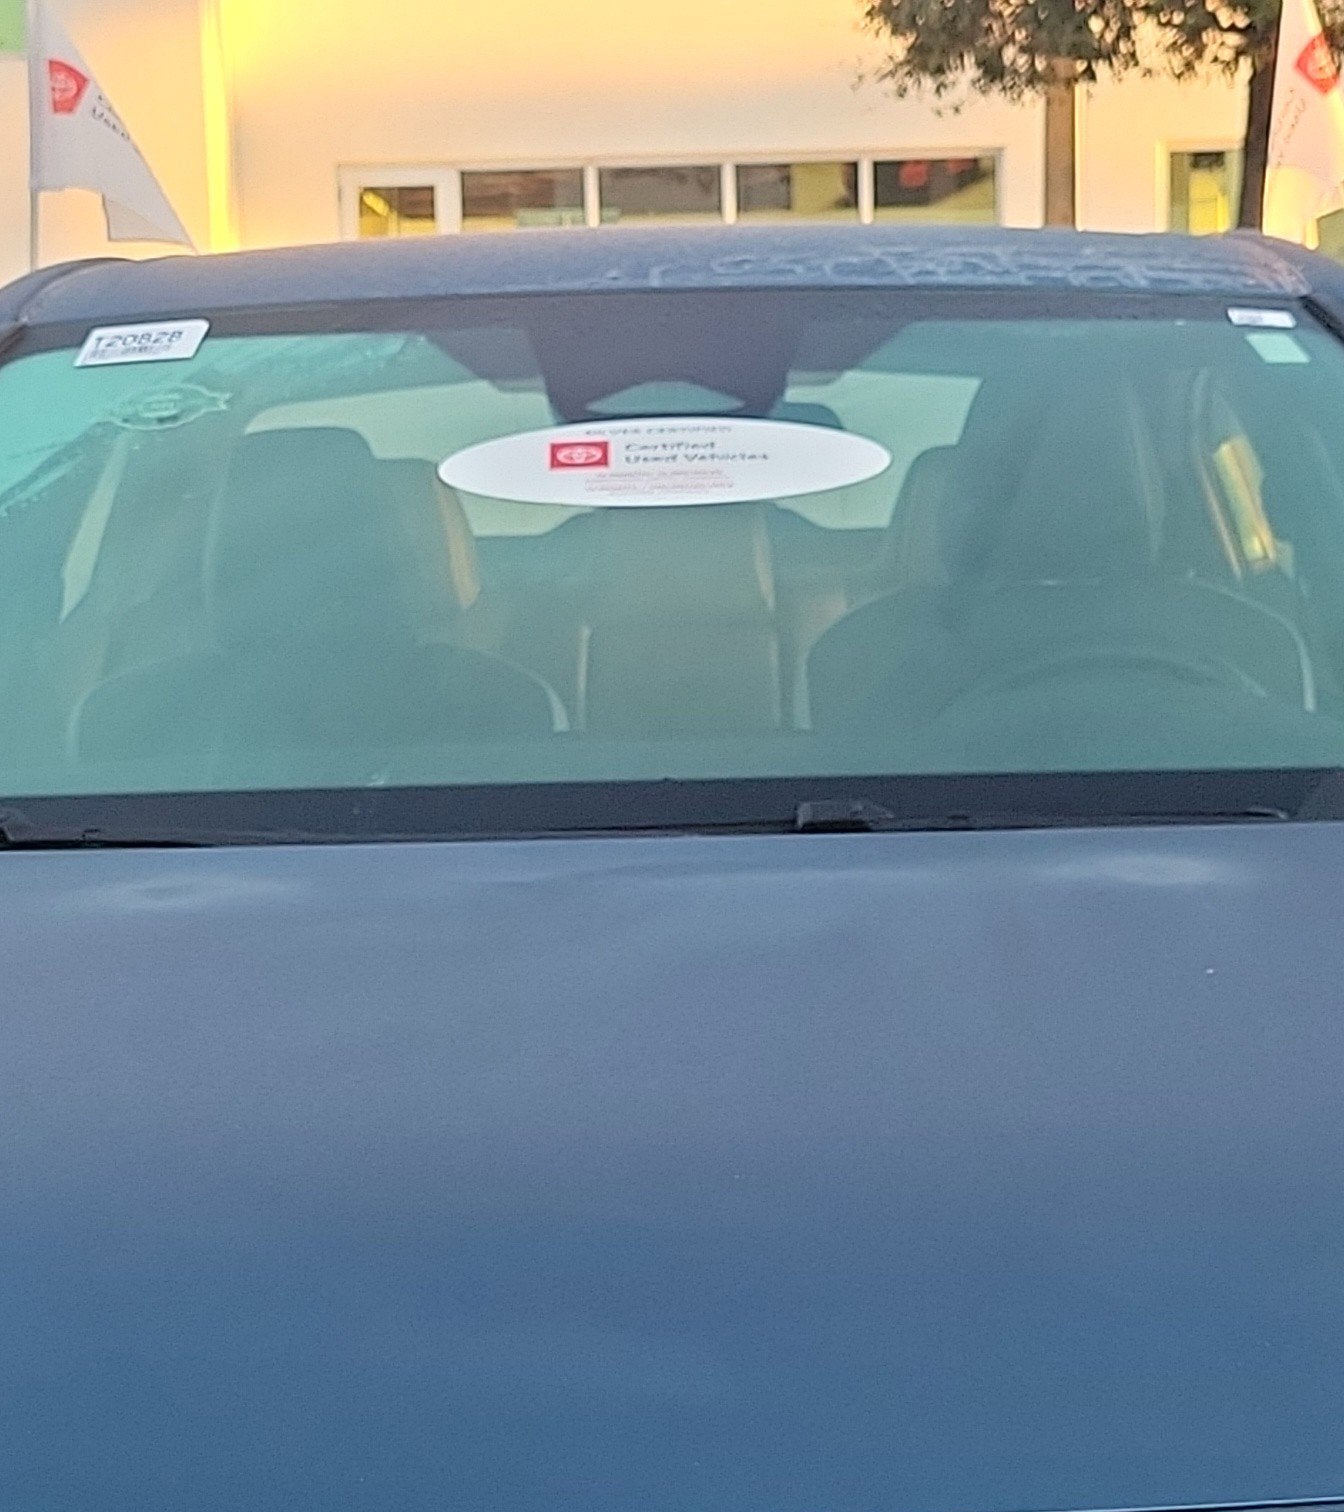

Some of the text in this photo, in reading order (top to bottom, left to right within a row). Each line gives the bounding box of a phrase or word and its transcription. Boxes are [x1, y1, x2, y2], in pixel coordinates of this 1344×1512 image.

[624, 440, 716, 452] Certified
[624, 452, 769, 464] Used Vehicles
